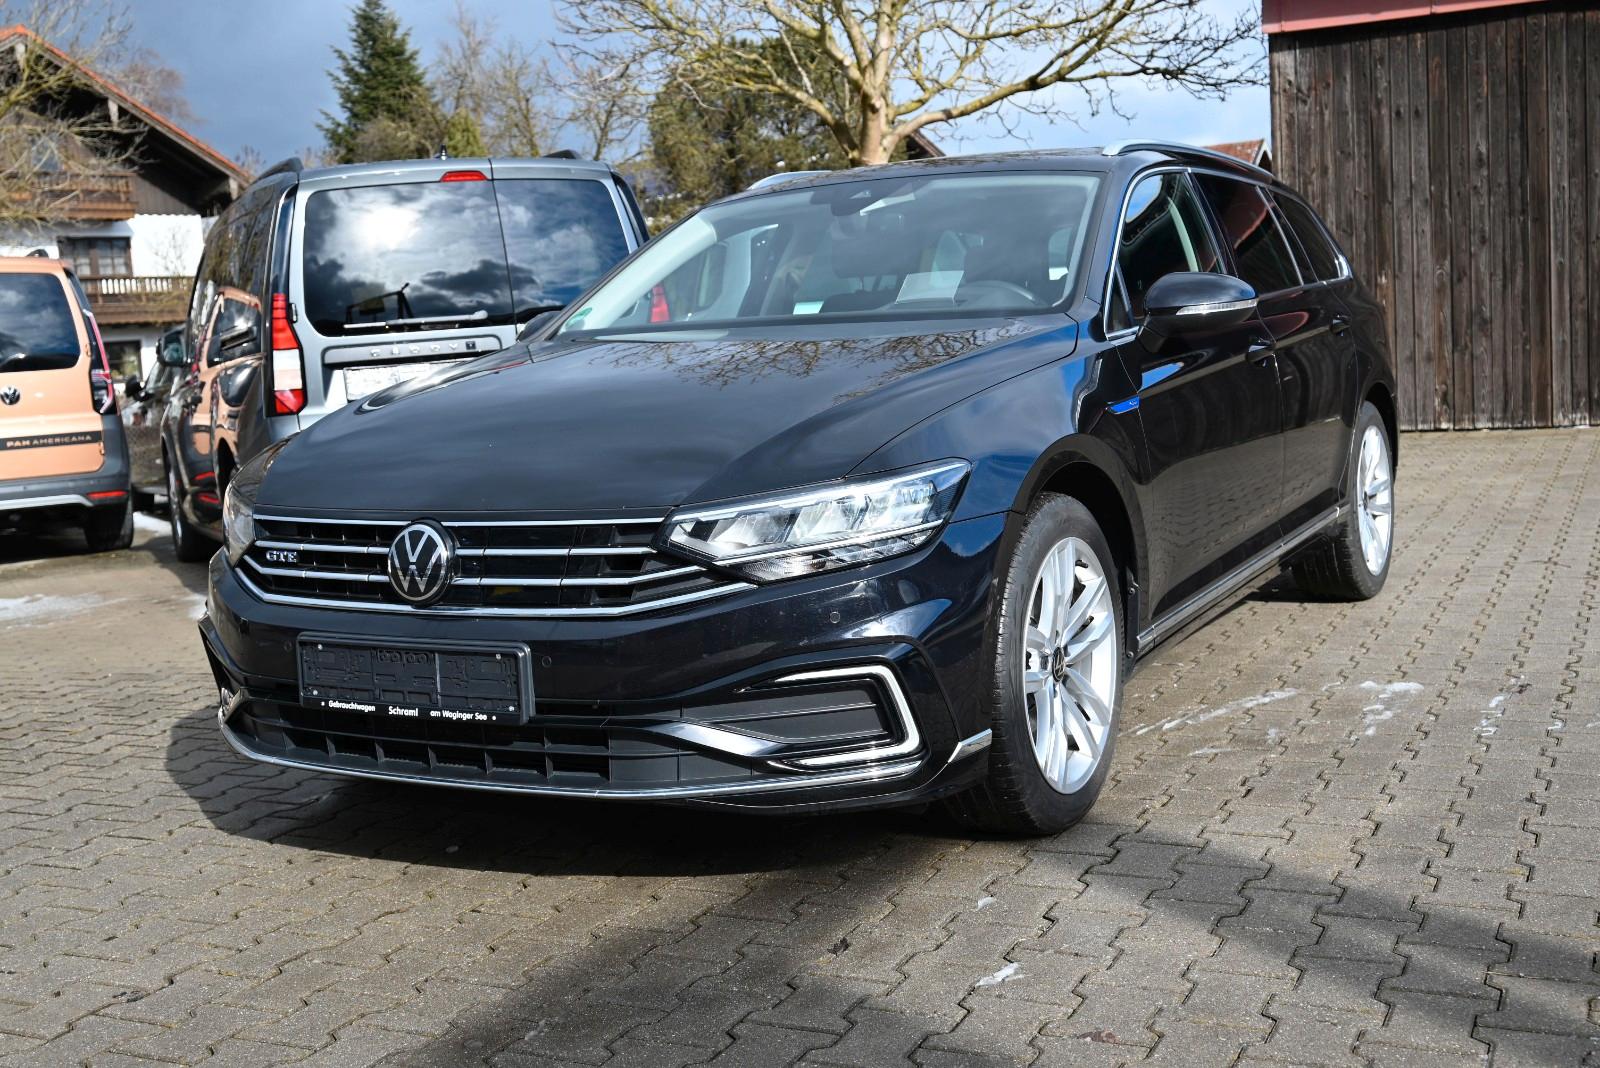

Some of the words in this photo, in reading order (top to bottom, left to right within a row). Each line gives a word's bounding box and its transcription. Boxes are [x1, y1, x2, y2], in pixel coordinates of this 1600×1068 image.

[266, 550, 297, 562] GTE
[388, 706, 419, 717] Schraml
[430, 710, 441, 718] am
[442, 710, 474, 720] Waginger
[475, 712, 488, 720] See
